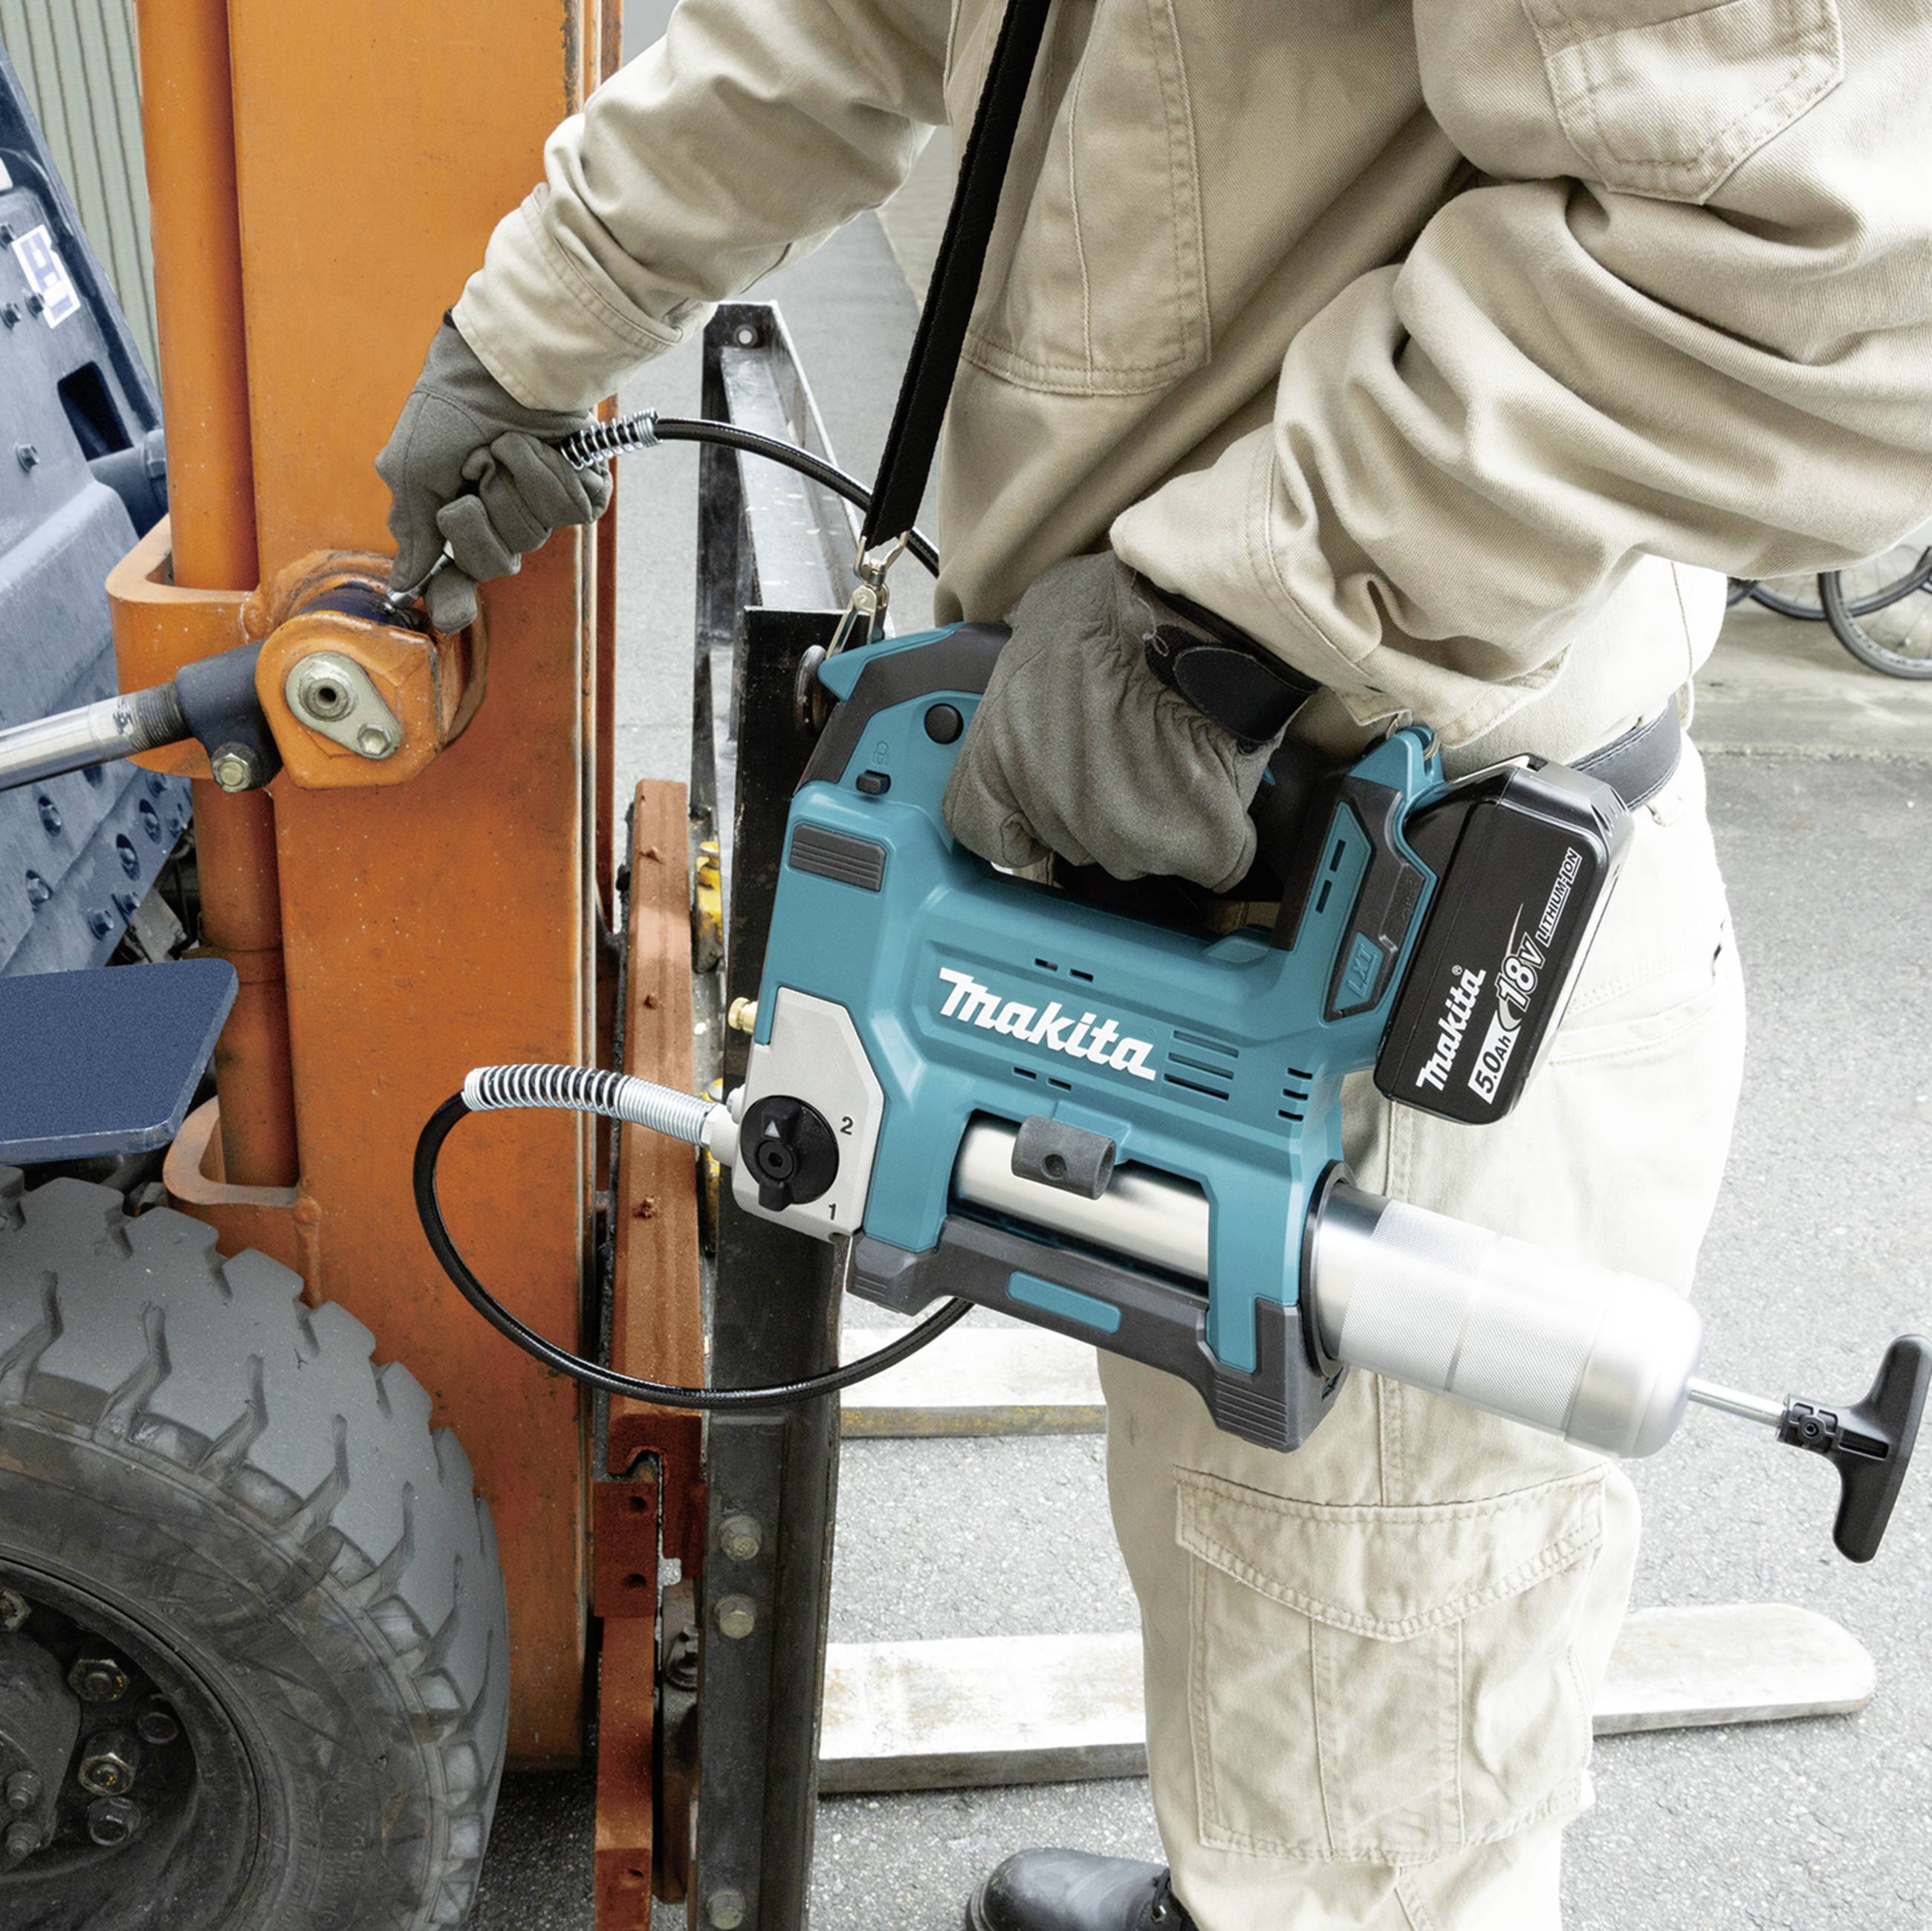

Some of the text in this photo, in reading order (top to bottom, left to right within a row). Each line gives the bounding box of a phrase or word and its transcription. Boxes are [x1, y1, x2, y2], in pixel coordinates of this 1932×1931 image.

[1347, 943, 1377, 999] LXT
[1474, 848, 1581, 1094] 5.0Ah 18V LITHIUM-ION
[939, 967, 1157, 1082] Makita
[1415, 968, 1487, 1091] Makita
[840, 1116, 854, 1135] 2
[828, 1203, 837, 1221] 1
